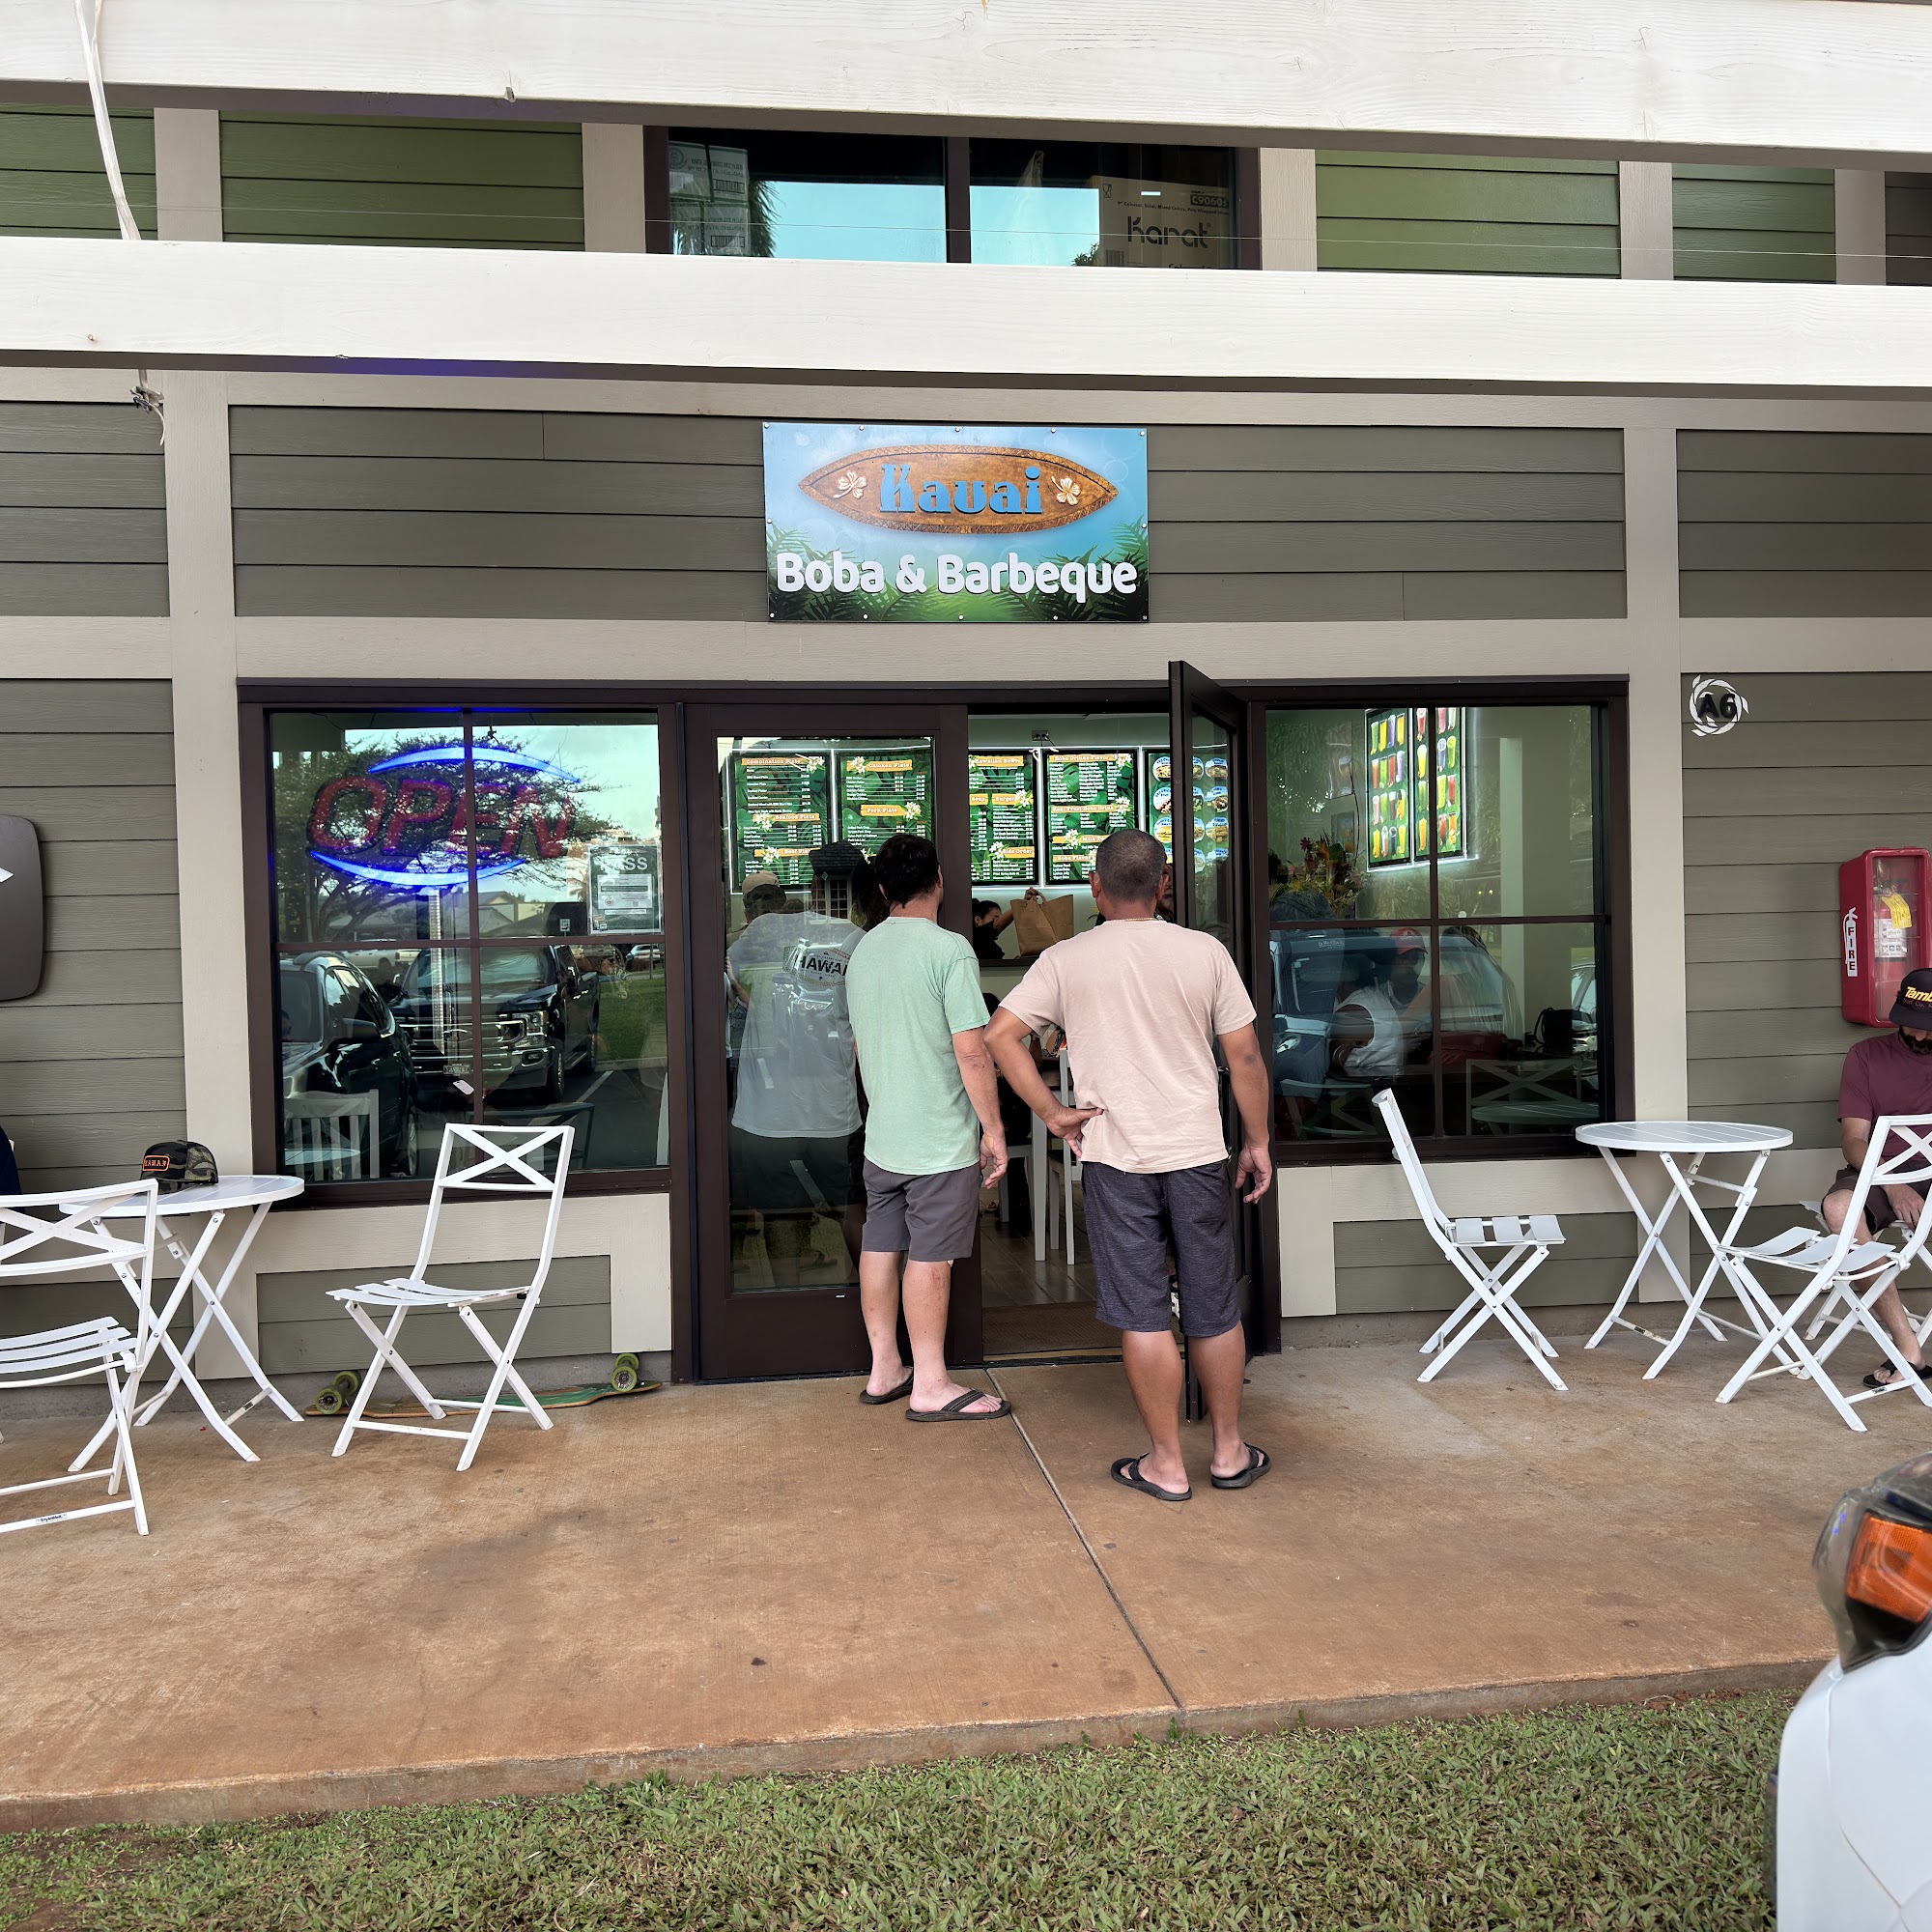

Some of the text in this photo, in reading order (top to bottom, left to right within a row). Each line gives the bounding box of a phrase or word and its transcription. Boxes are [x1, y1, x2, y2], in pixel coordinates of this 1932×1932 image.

[880, 463, 1043, 515] Kauai
[776, 551, 1138, 604] Boba & Barbeque
[1697, 693, 1738, 719] A6
[307, 776, 577, 859] OPEN
[1847, 926, 1857, 971] FIRE
